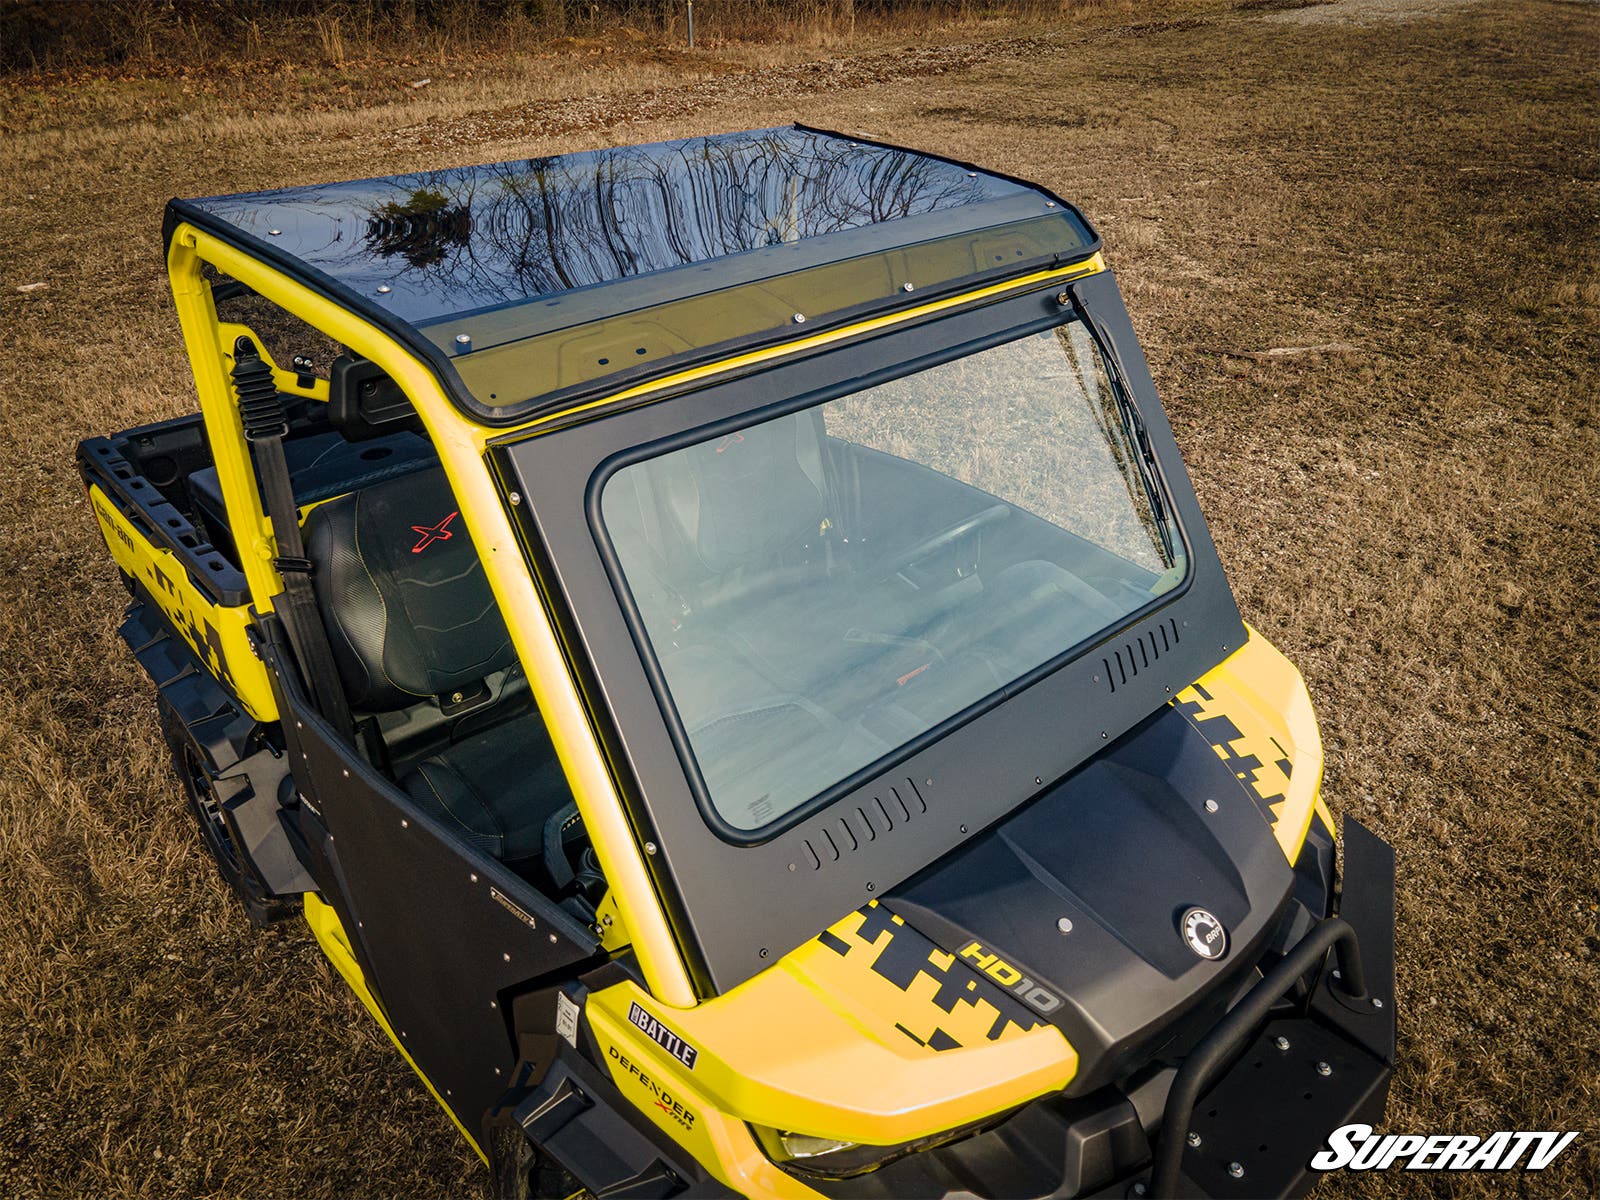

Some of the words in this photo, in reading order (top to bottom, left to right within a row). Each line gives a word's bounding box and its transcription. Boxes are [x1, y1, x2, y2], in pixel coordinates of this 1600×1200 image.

[1205, 926, 1221, 944] BRP
[959, 942, 1061, 1012] HD10
[637, 1009, 695, 1066] BATTLE
[609, 1046, 695, 1125] DEFENDER
